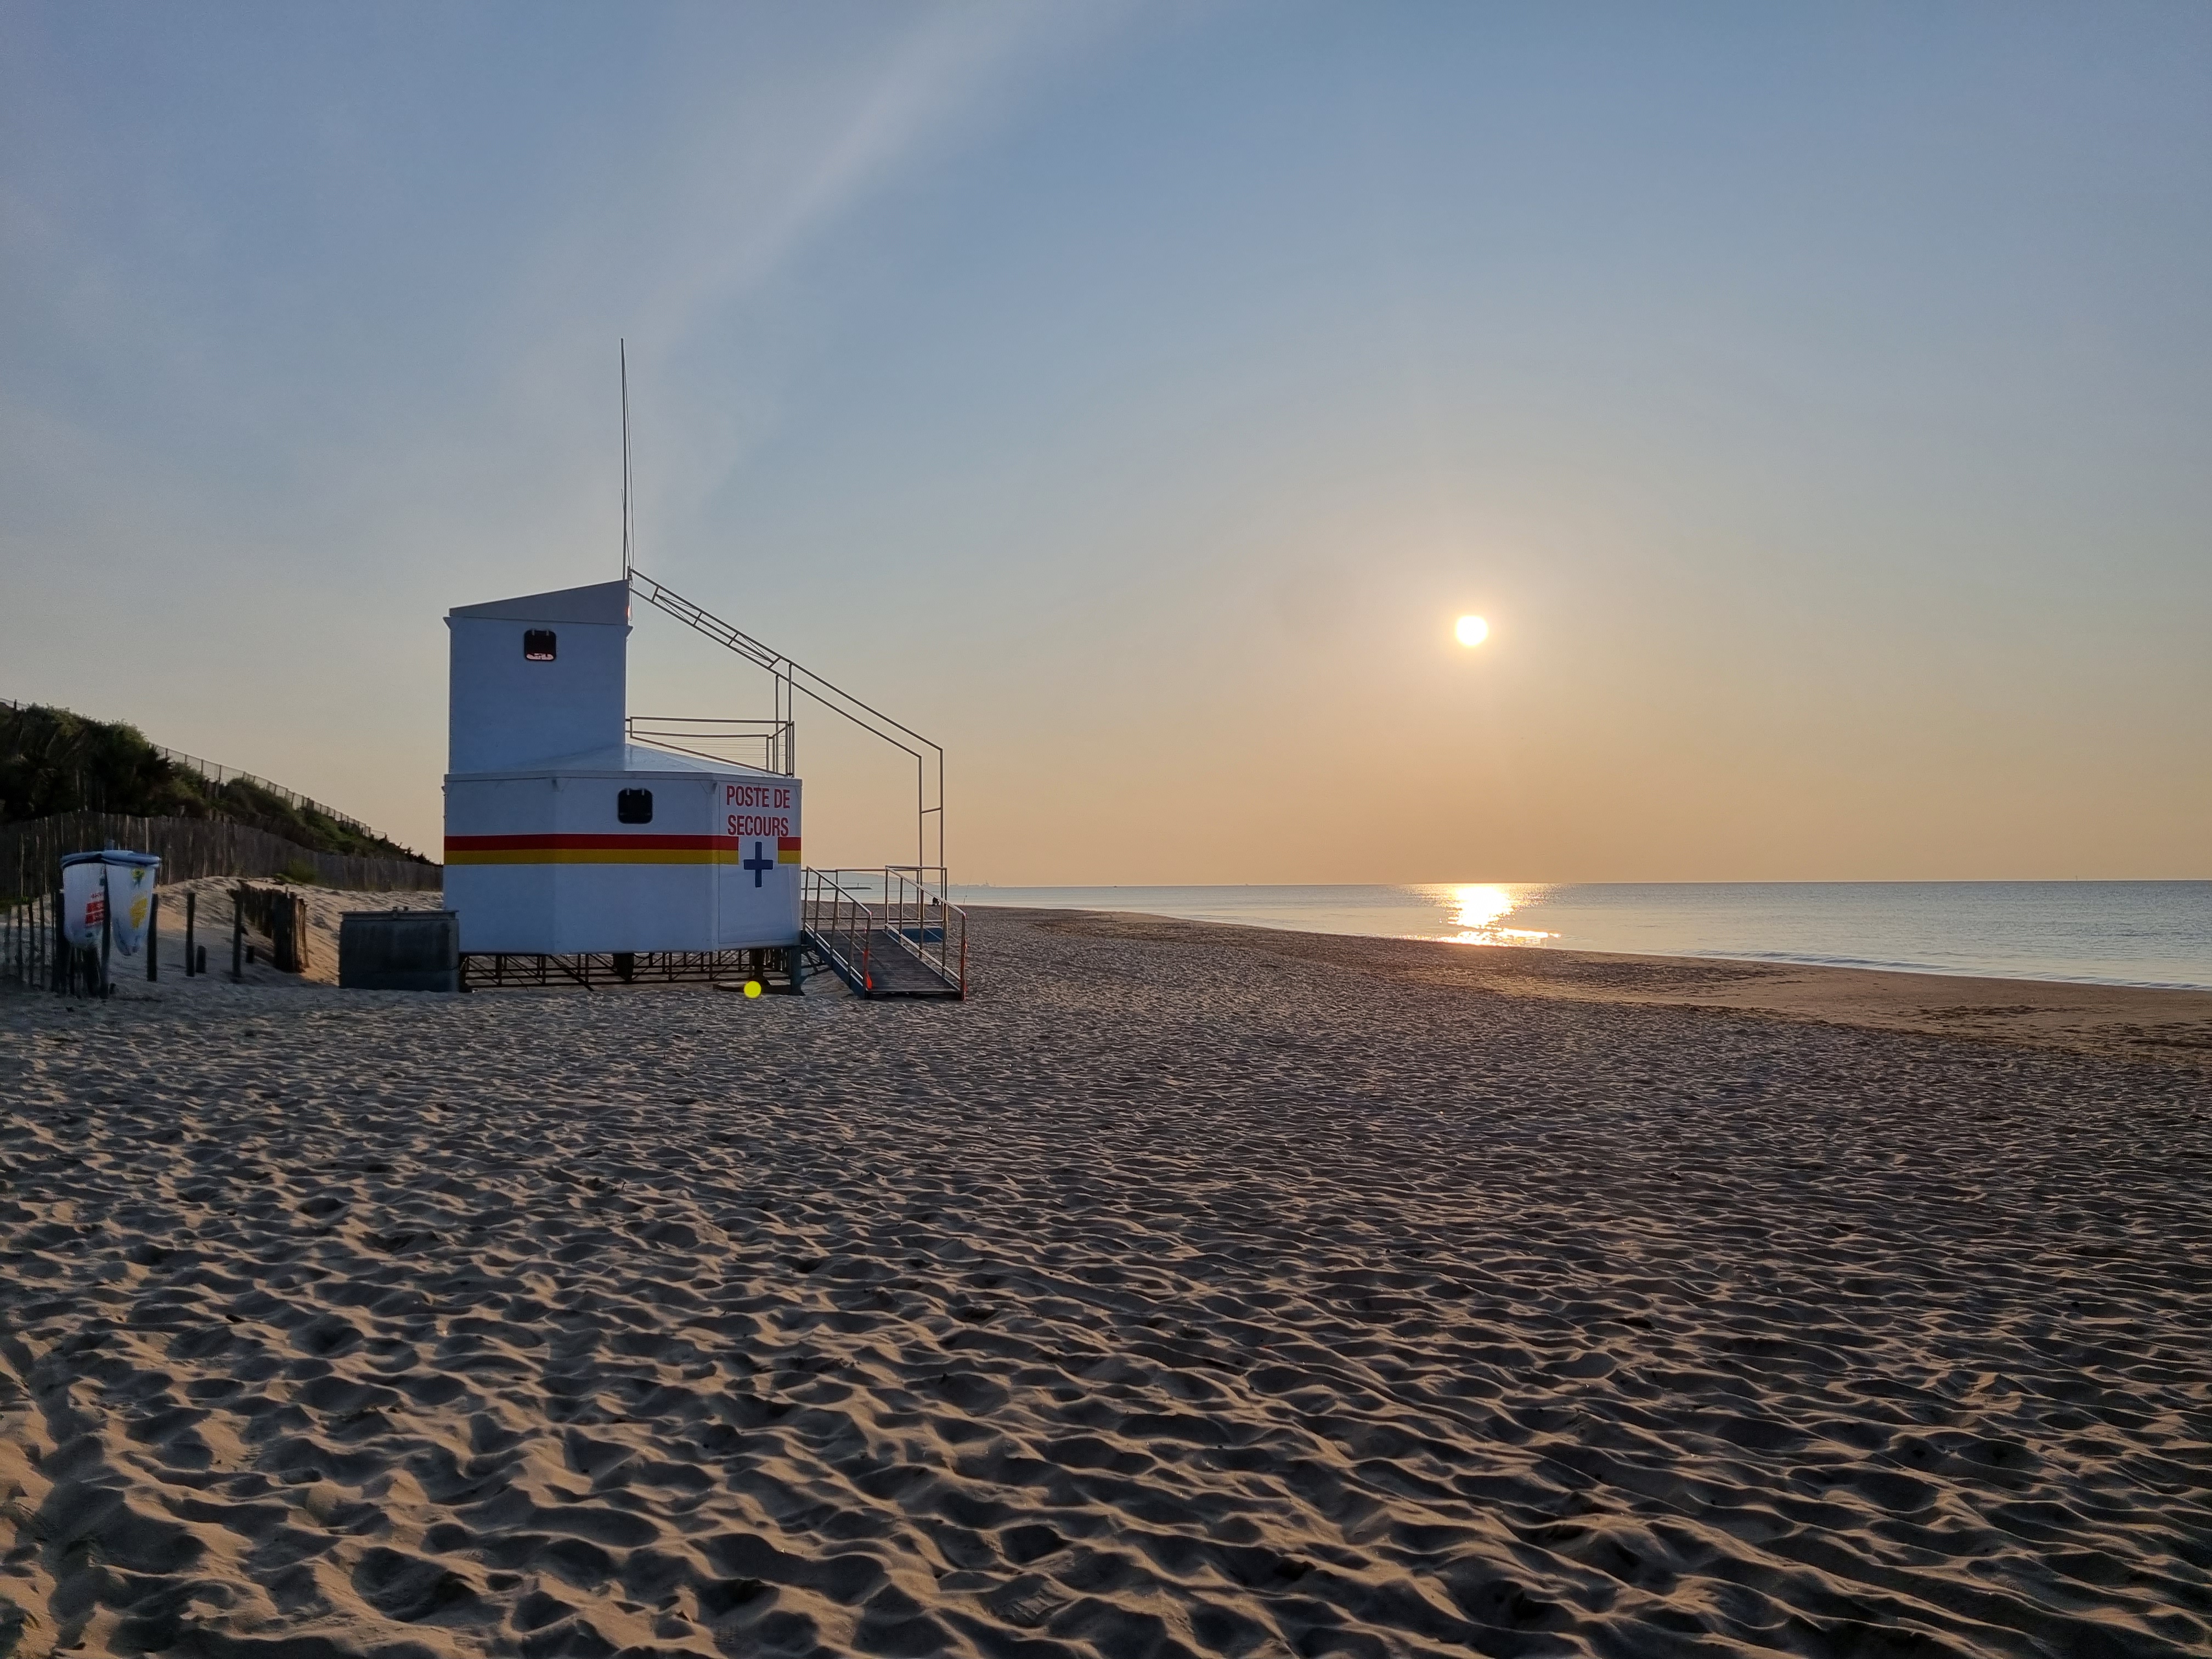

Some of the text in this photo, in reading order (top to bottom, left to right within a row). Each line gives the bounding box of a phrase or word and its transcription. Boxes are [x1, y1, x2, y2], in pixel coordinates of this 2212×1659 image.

[726, 785, 790, 809] POSTE DE
[727, 815, 788, 836] SECOURS
